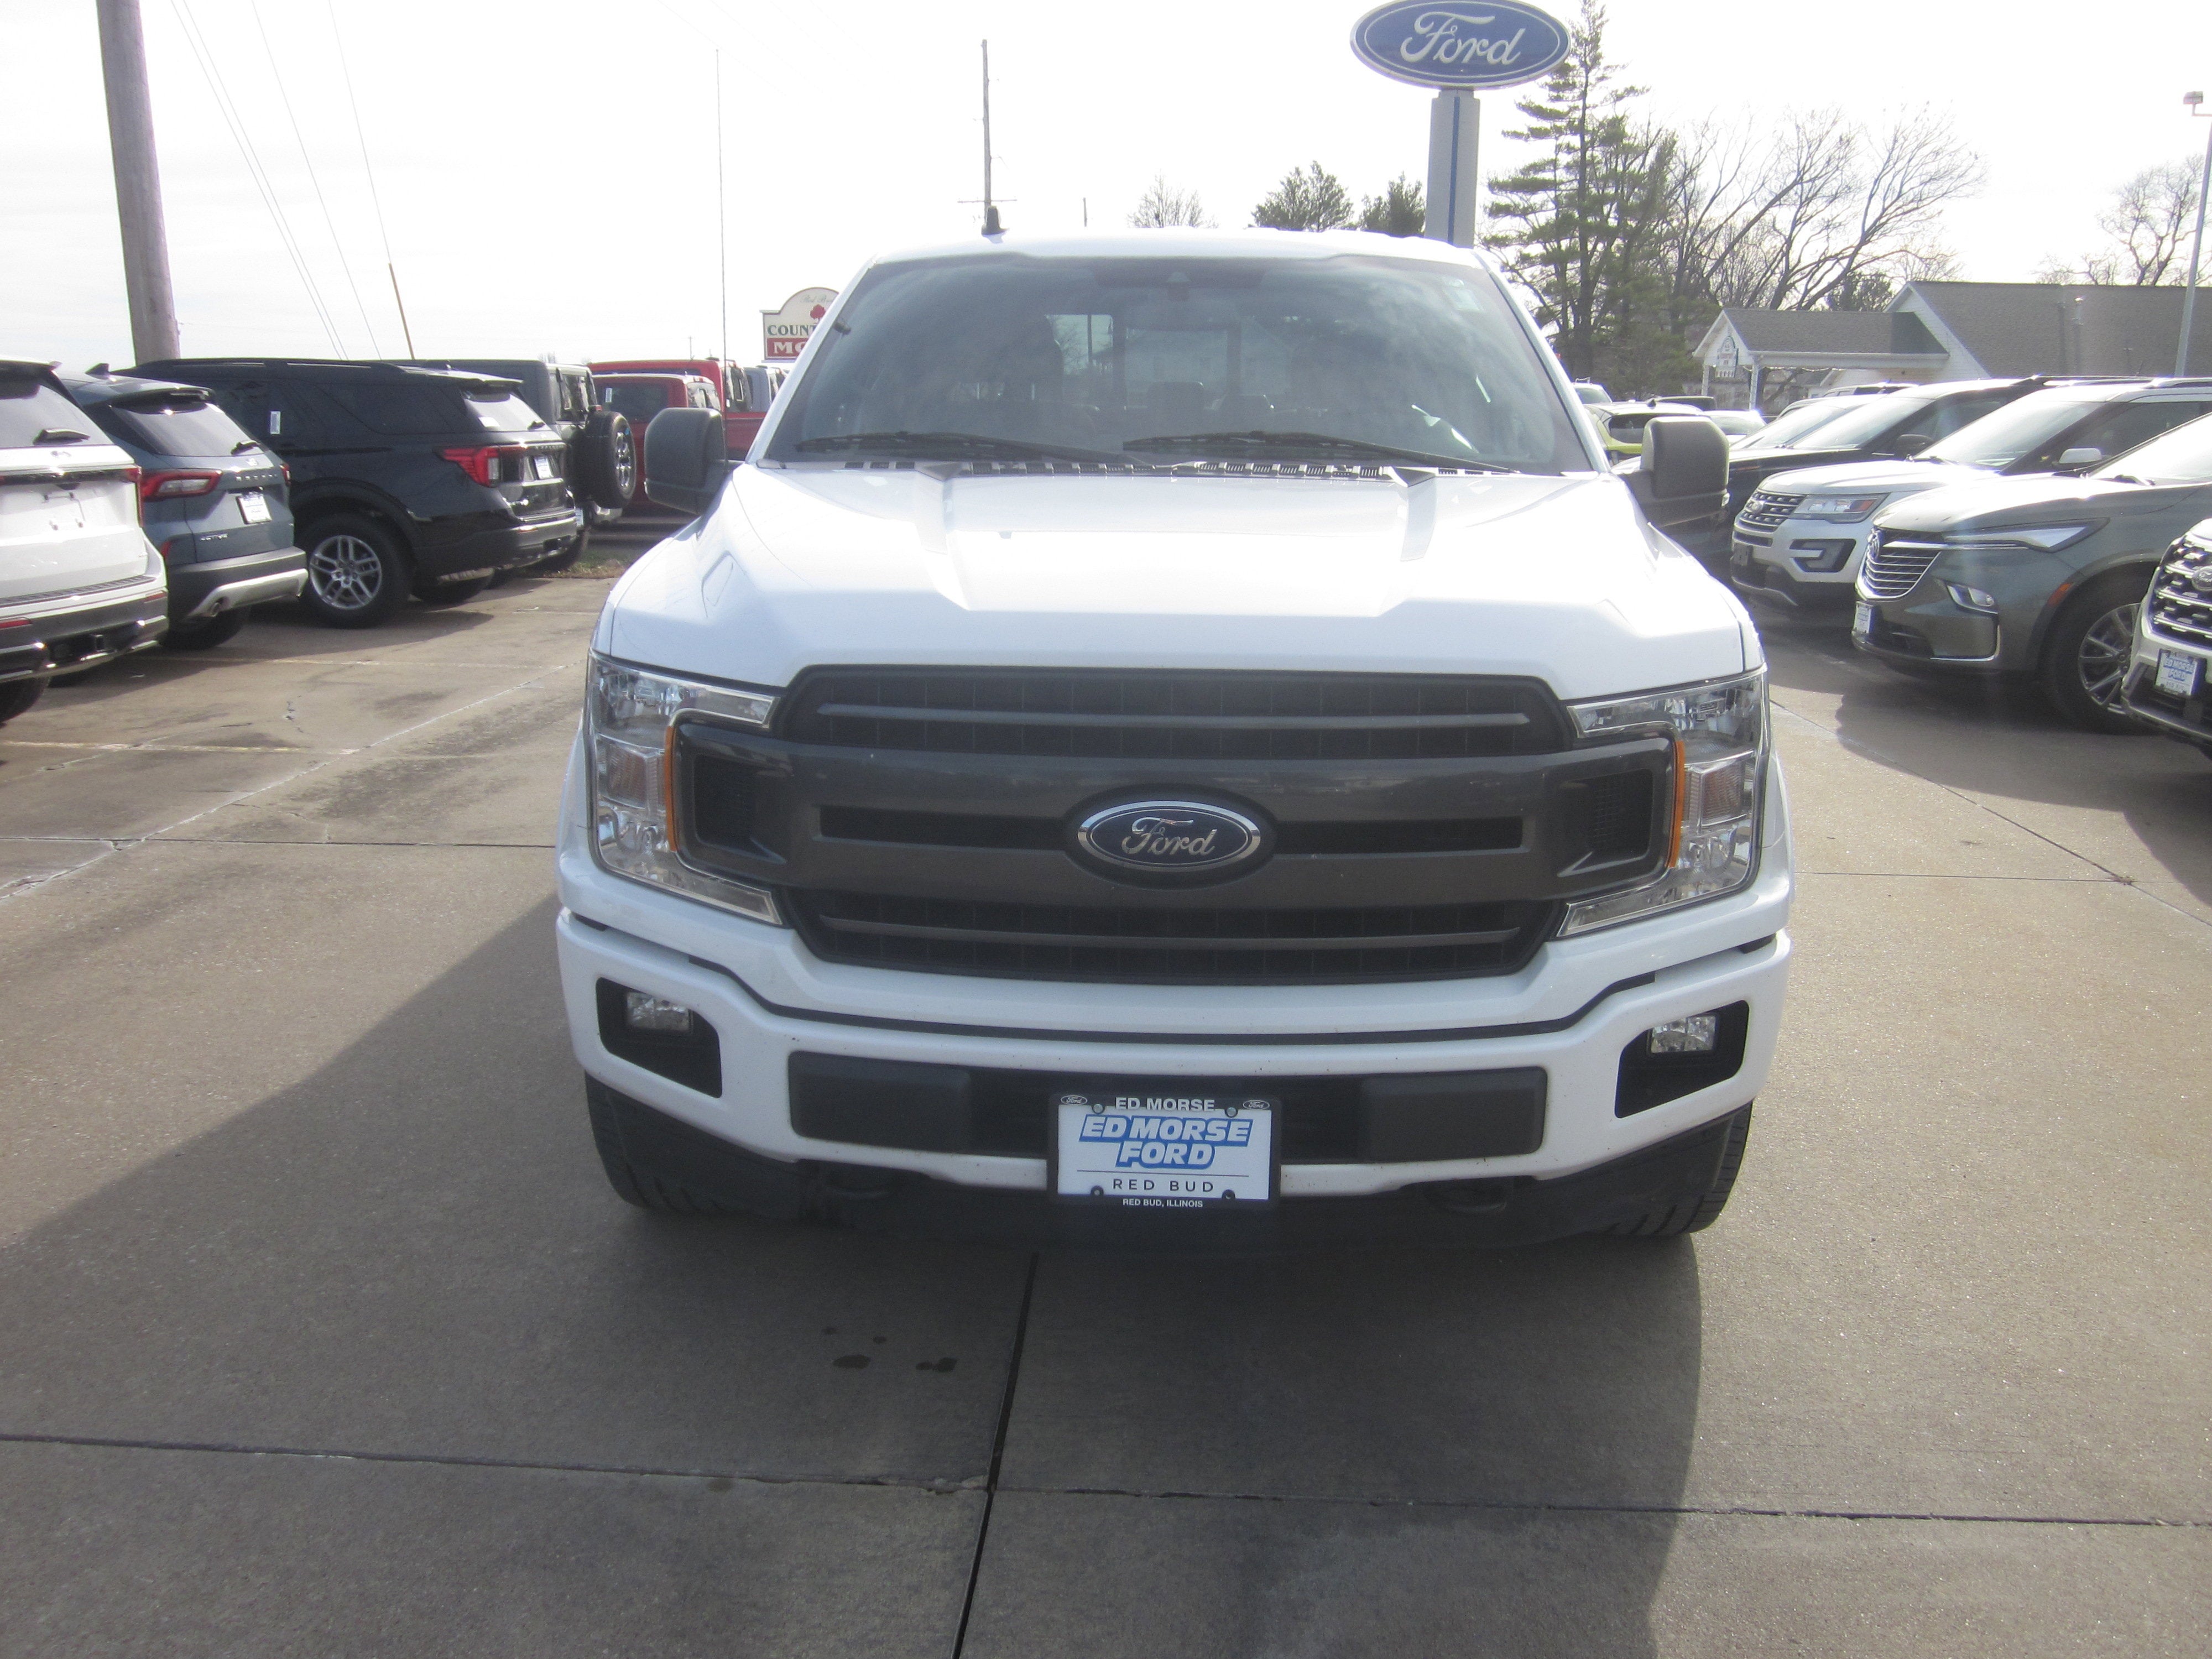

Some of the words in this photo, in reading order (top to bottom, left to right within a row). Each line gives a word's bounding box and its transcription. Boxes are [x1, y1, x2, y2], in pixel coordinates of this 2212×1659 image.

[1400, 11, 1526, 65] Ford
[1121, 817, 1217, 855] Ford
[1115, 1097, 1140, 1110] ED
[1147, 1098, 1215, 1112] MORSE
[1117, 1141, 1215, 1169] FORD
[1113, 1178, 1155, 1190] RED
[1170, 1181, 1213, 1192] BUD
